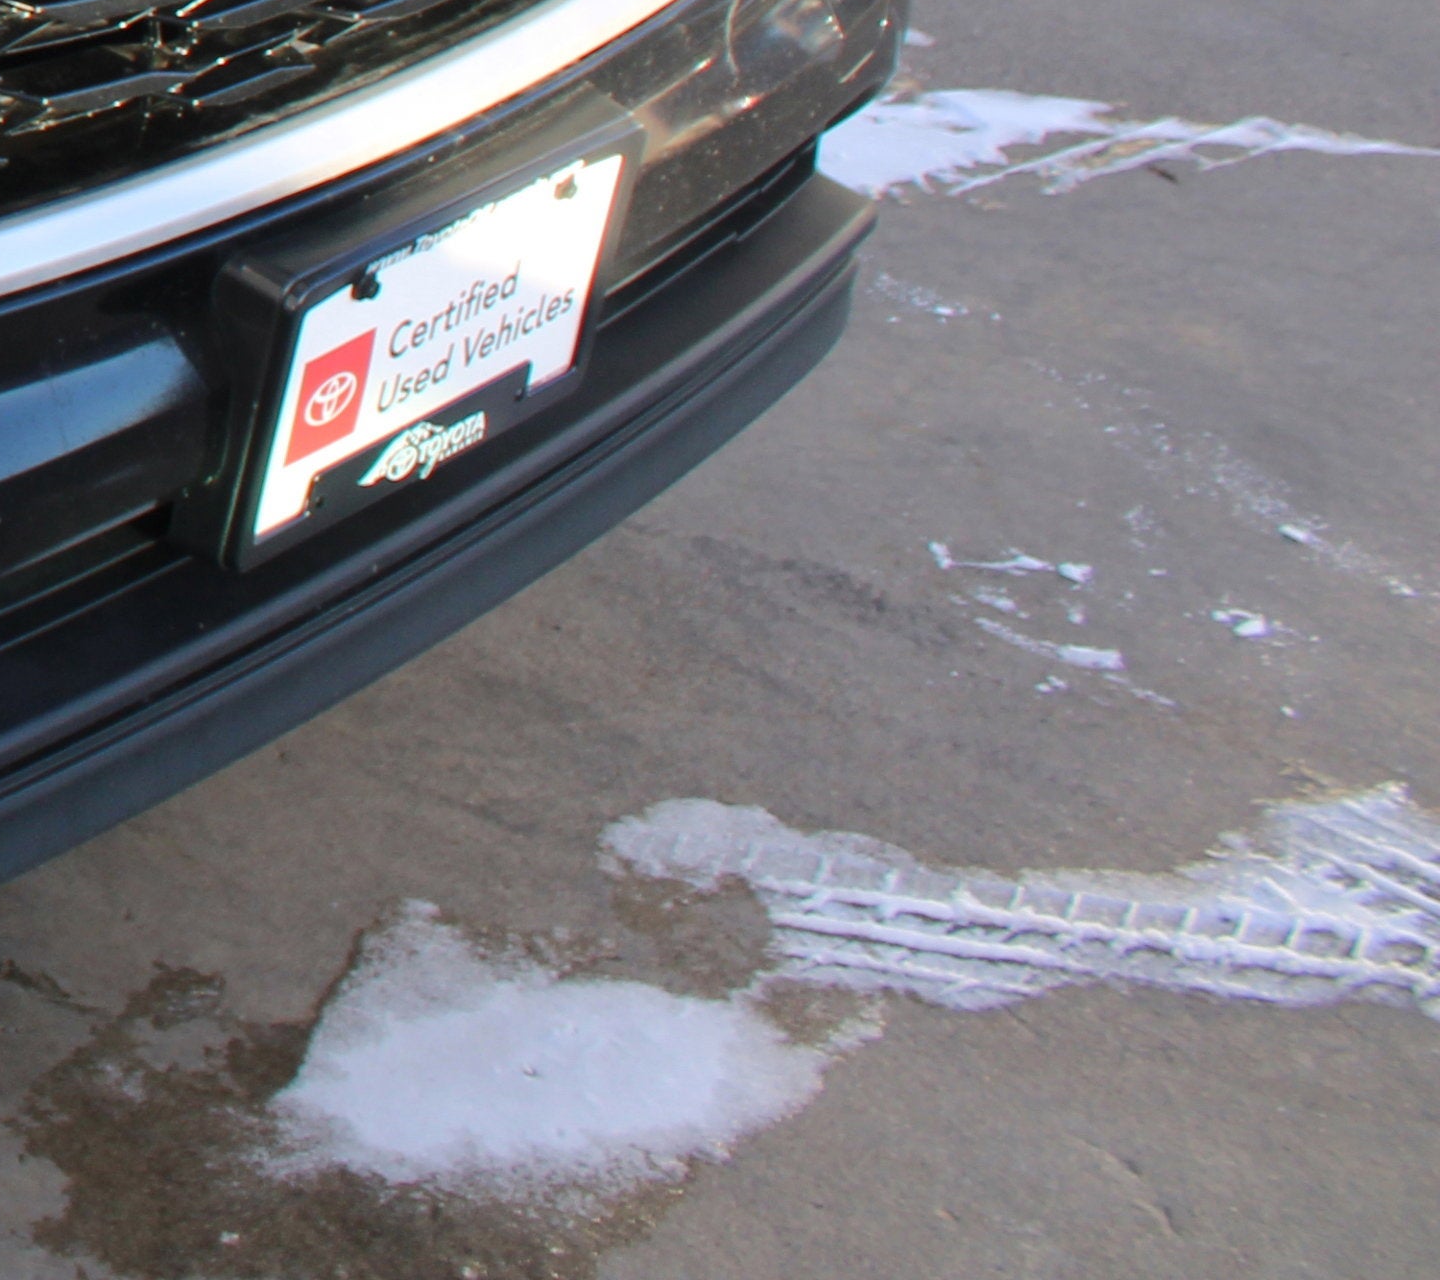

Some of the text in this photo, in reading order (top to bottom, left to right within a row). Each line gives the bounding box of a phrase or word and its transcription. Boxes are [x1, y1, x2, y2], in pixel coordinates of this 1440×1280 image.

[377, 287, 575, 413] Used Vehicles
[390, 259, 521, 358] Certified
[418, 411, 486, 463] TOYOTA
